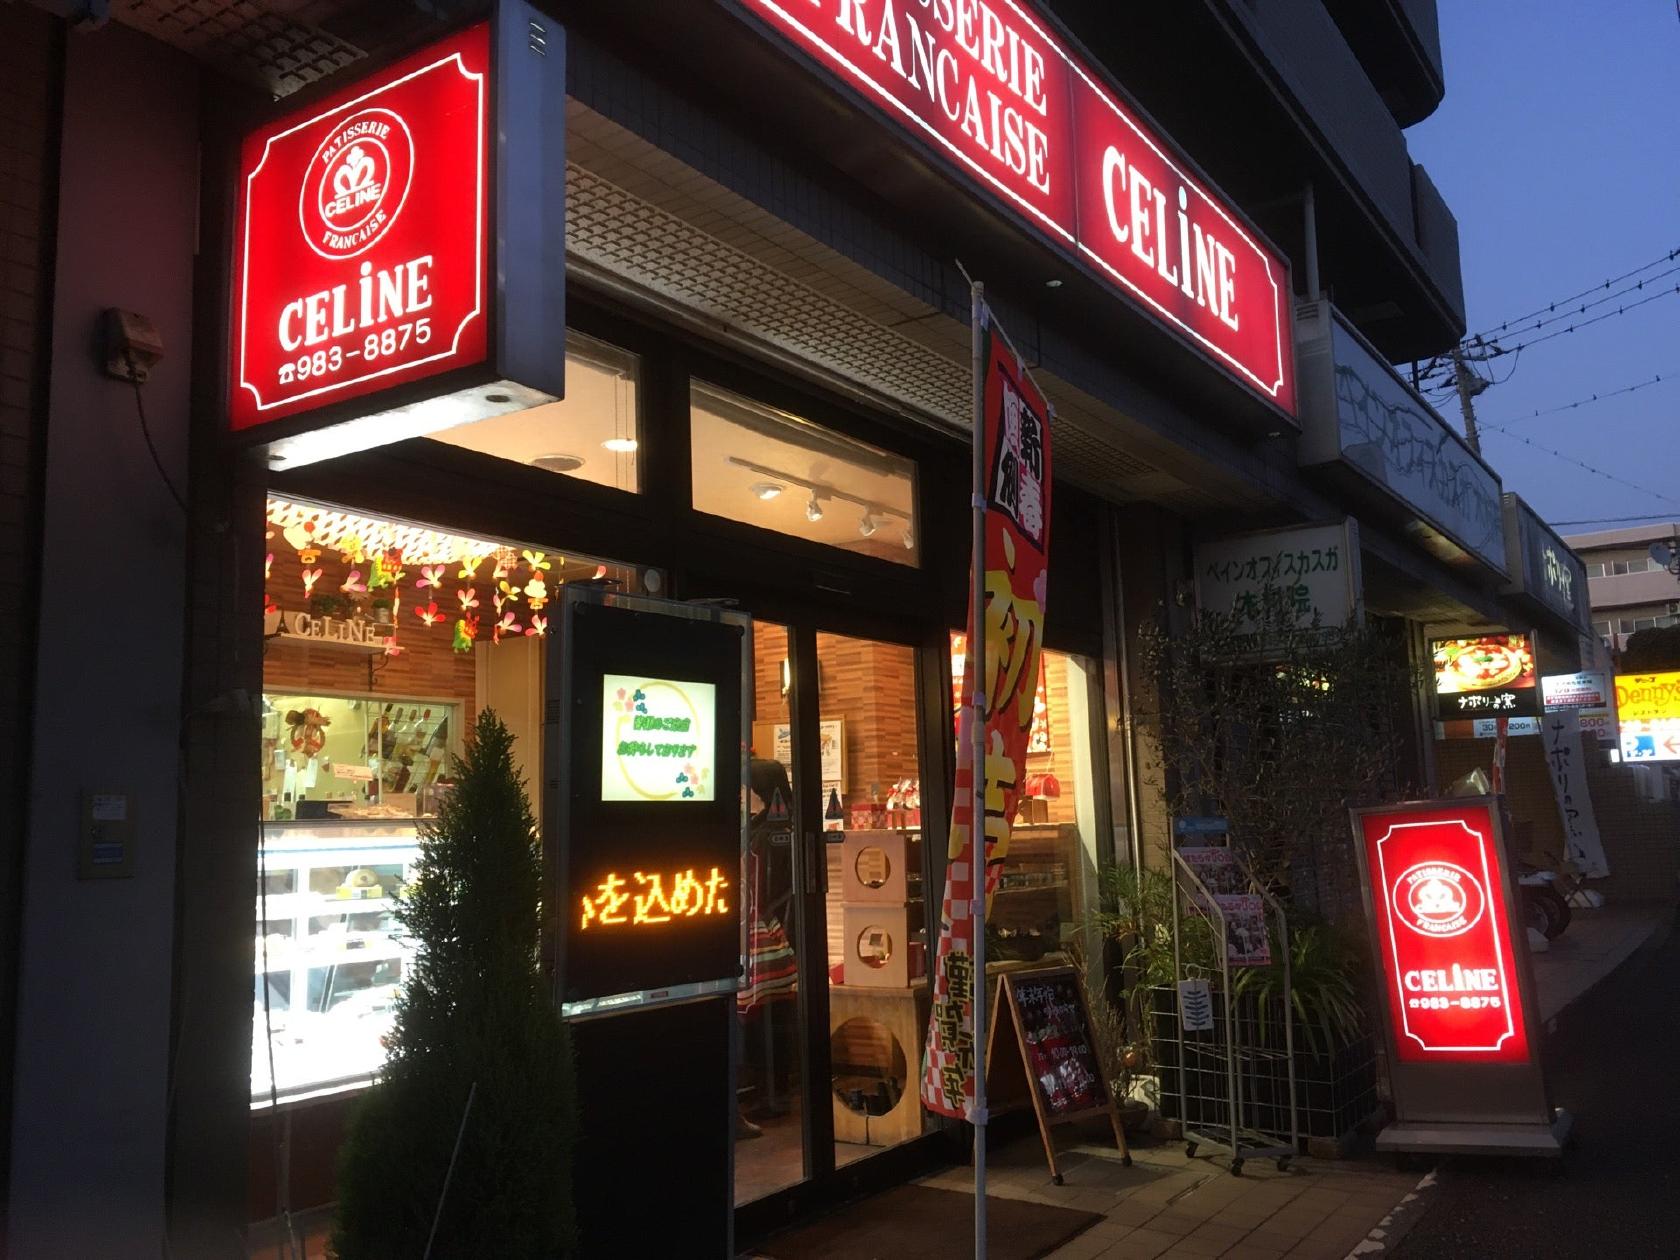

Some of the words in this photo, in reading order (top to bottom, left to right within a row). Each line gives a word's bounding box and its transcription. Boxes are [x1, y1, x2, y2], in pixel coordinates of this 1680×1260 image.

[919, 0, 1047, 116] SERIE
[808, 0, 1050, 195] RANCAISE
[322, 121, 391, 164] PATISSERIE
[324, 183, 382, 218] CELINE
[297, 318, 431, 381] 983-8875
